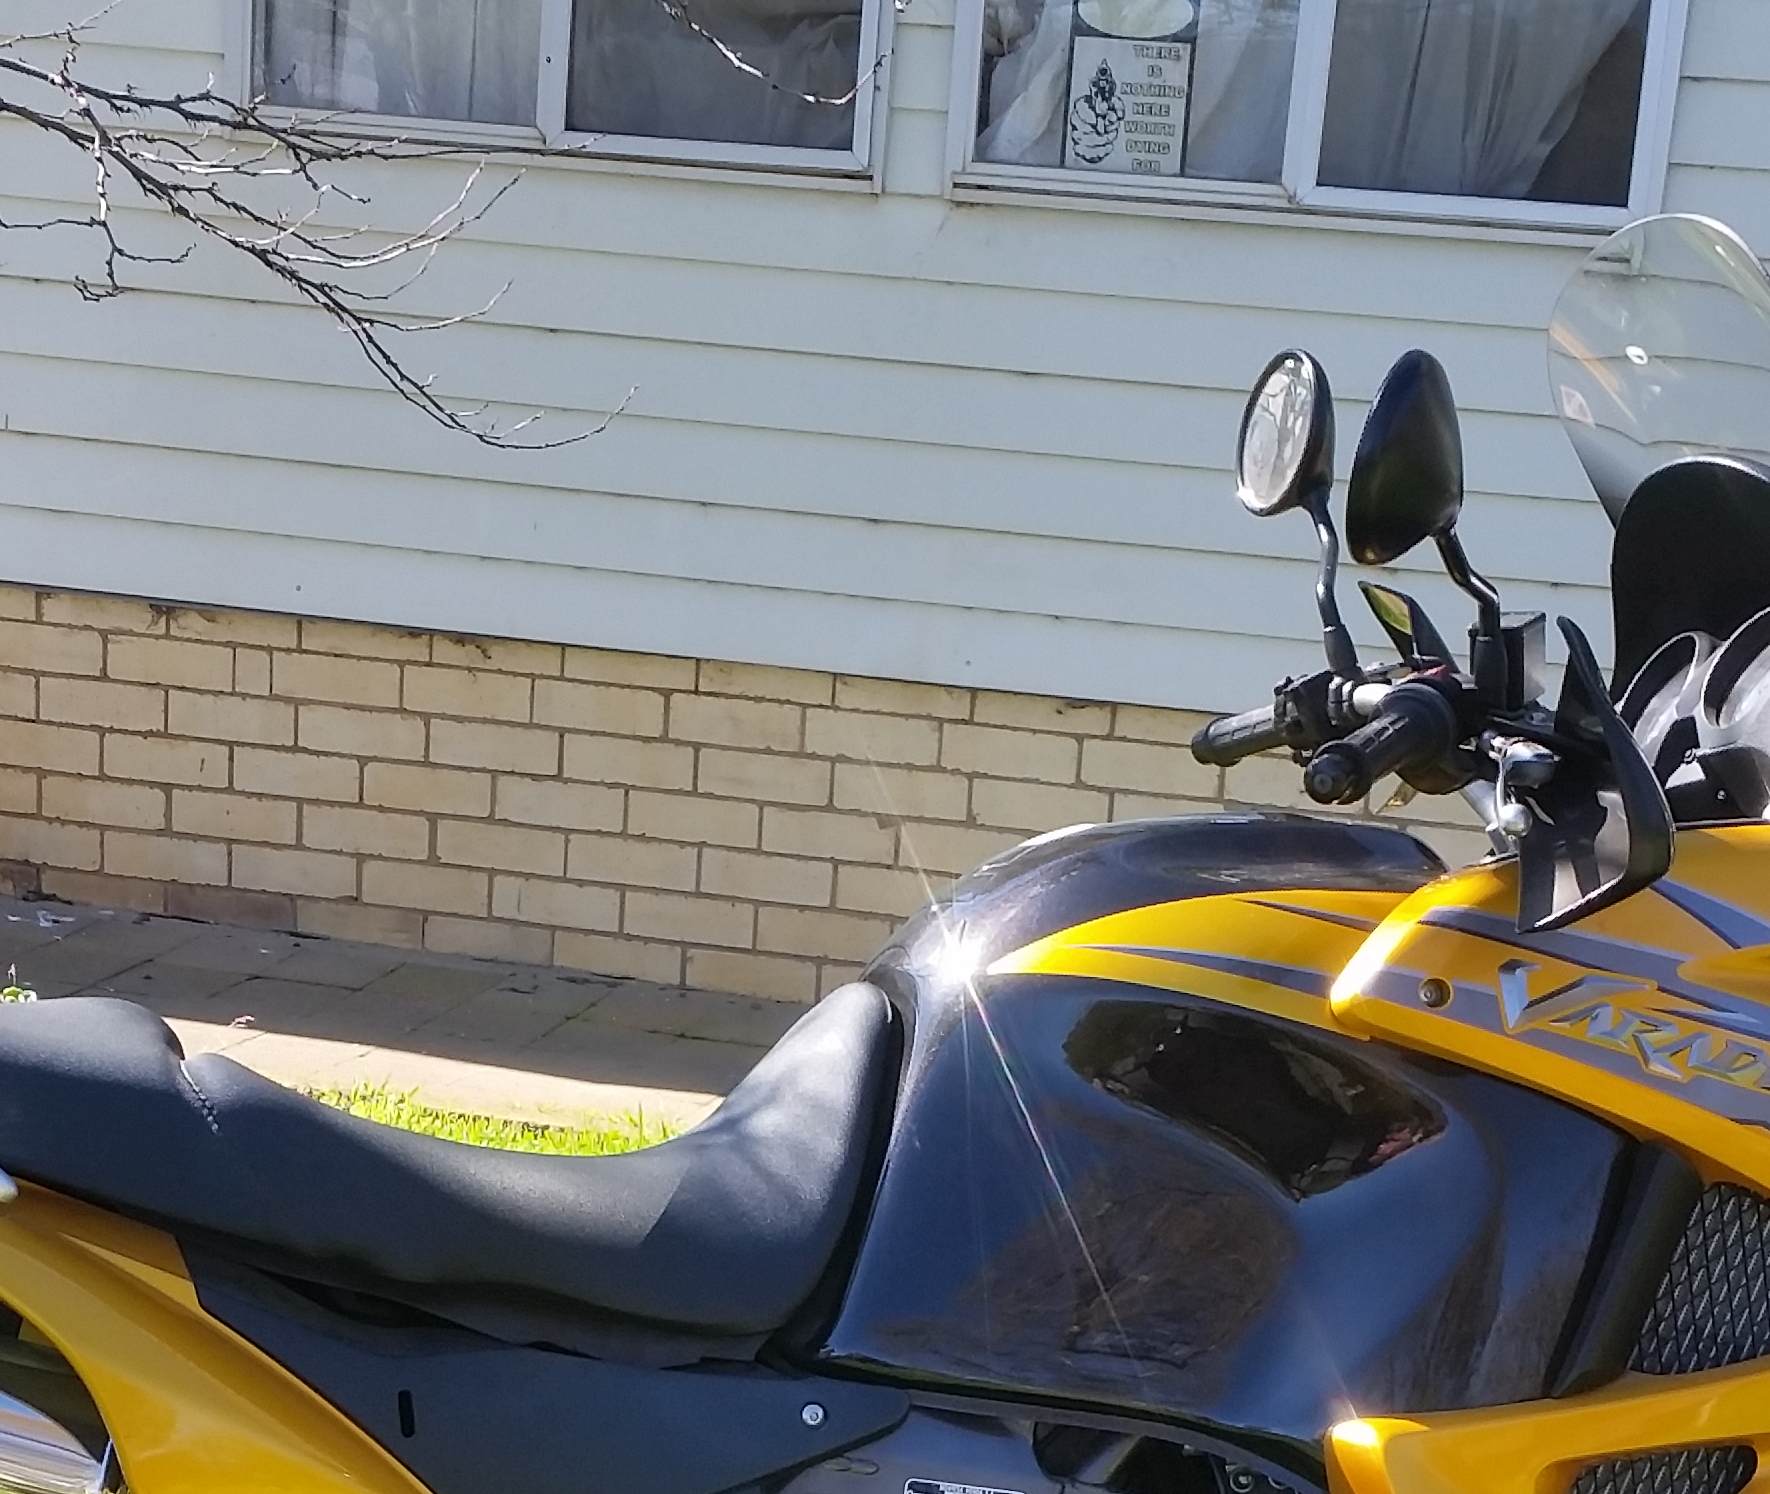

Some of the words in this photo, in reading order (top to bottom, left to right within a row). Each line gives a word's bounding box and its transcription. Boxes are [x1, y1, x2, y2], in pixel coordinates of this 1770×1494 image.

[1133, 44, 1182, 61] THERE
[1147, 64, 1163, 78] IS
[1120, 82, 1185, 98] NOTHING
[1132, 102, 1171, 117] HERE
[1124, 120, 1176, 137] WORTH
[1125, 139, 1171, 155] DYING
[1131, 158, 1161, 173] FOR
